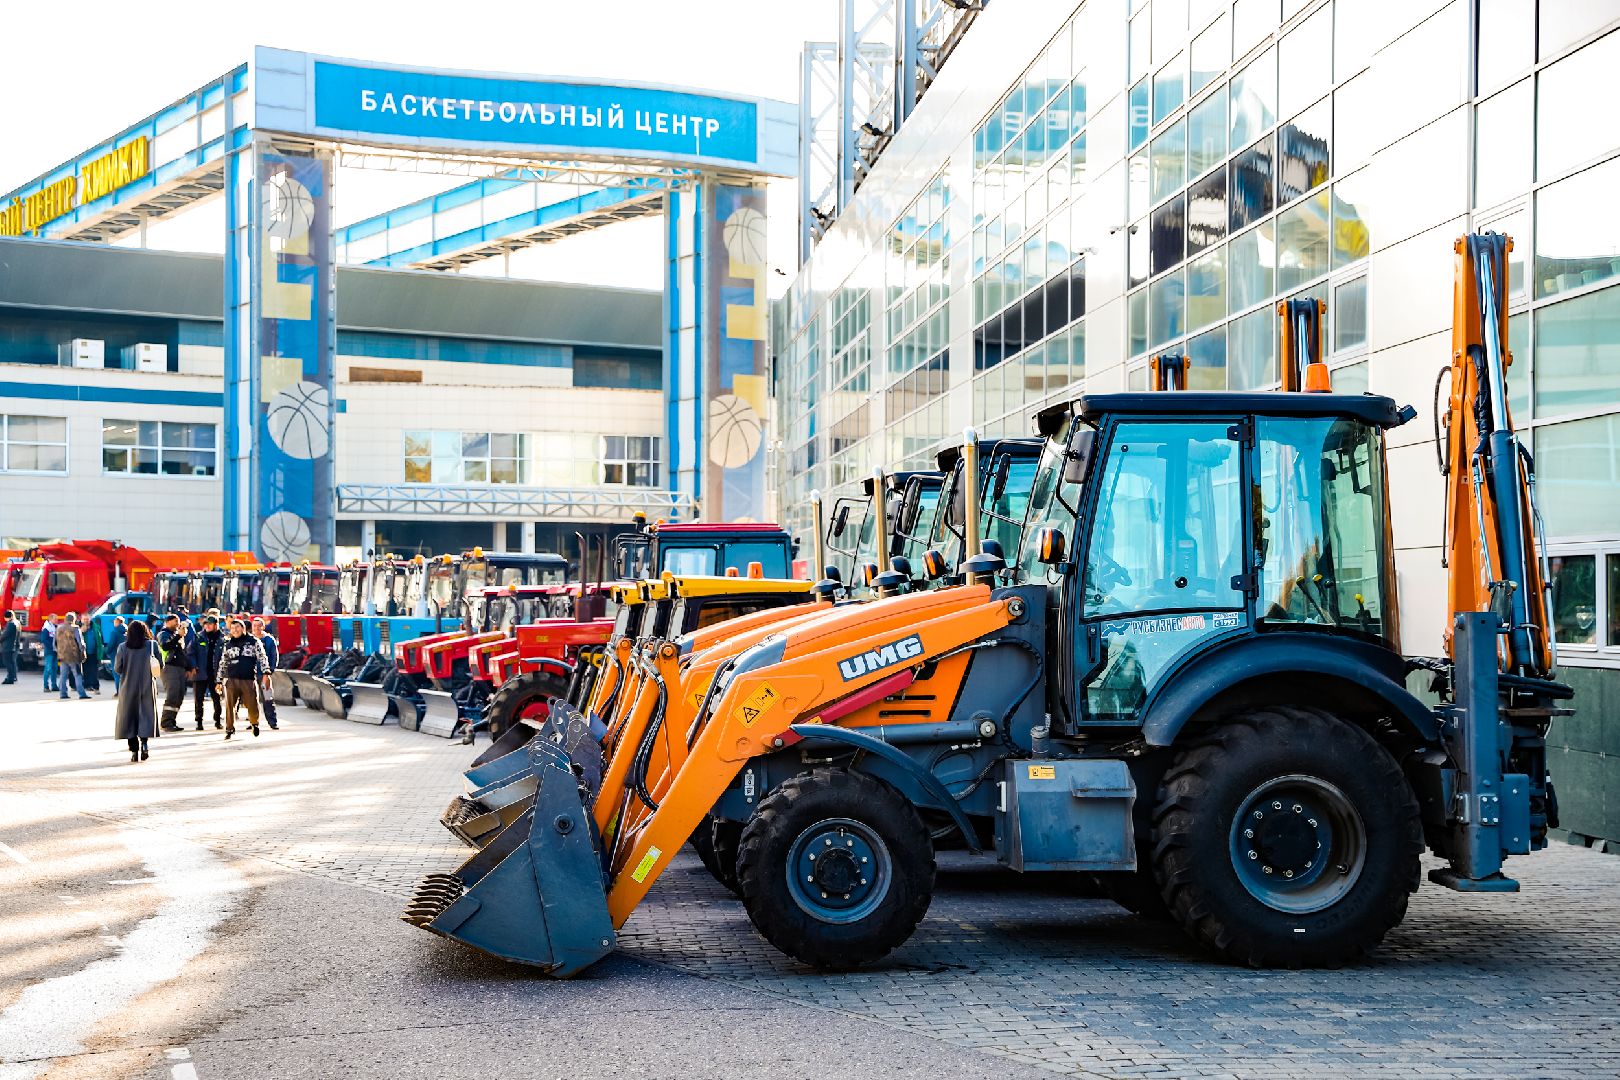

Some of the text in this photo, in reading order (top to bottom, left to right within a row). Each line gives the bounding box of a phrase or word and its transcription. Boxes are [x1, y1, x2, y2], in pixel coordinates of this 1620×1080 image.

[361, 89, 720, 138] БАСКЕТБОЛЬНЫЙ ЦЕНТР
[25, 176, 77, 237] ЦЕНТР
[81, 135, 148, 206] ХИМКИ
[1220, 618, 1236, 626] 1993
[839, 636, 922, 679] UMG
